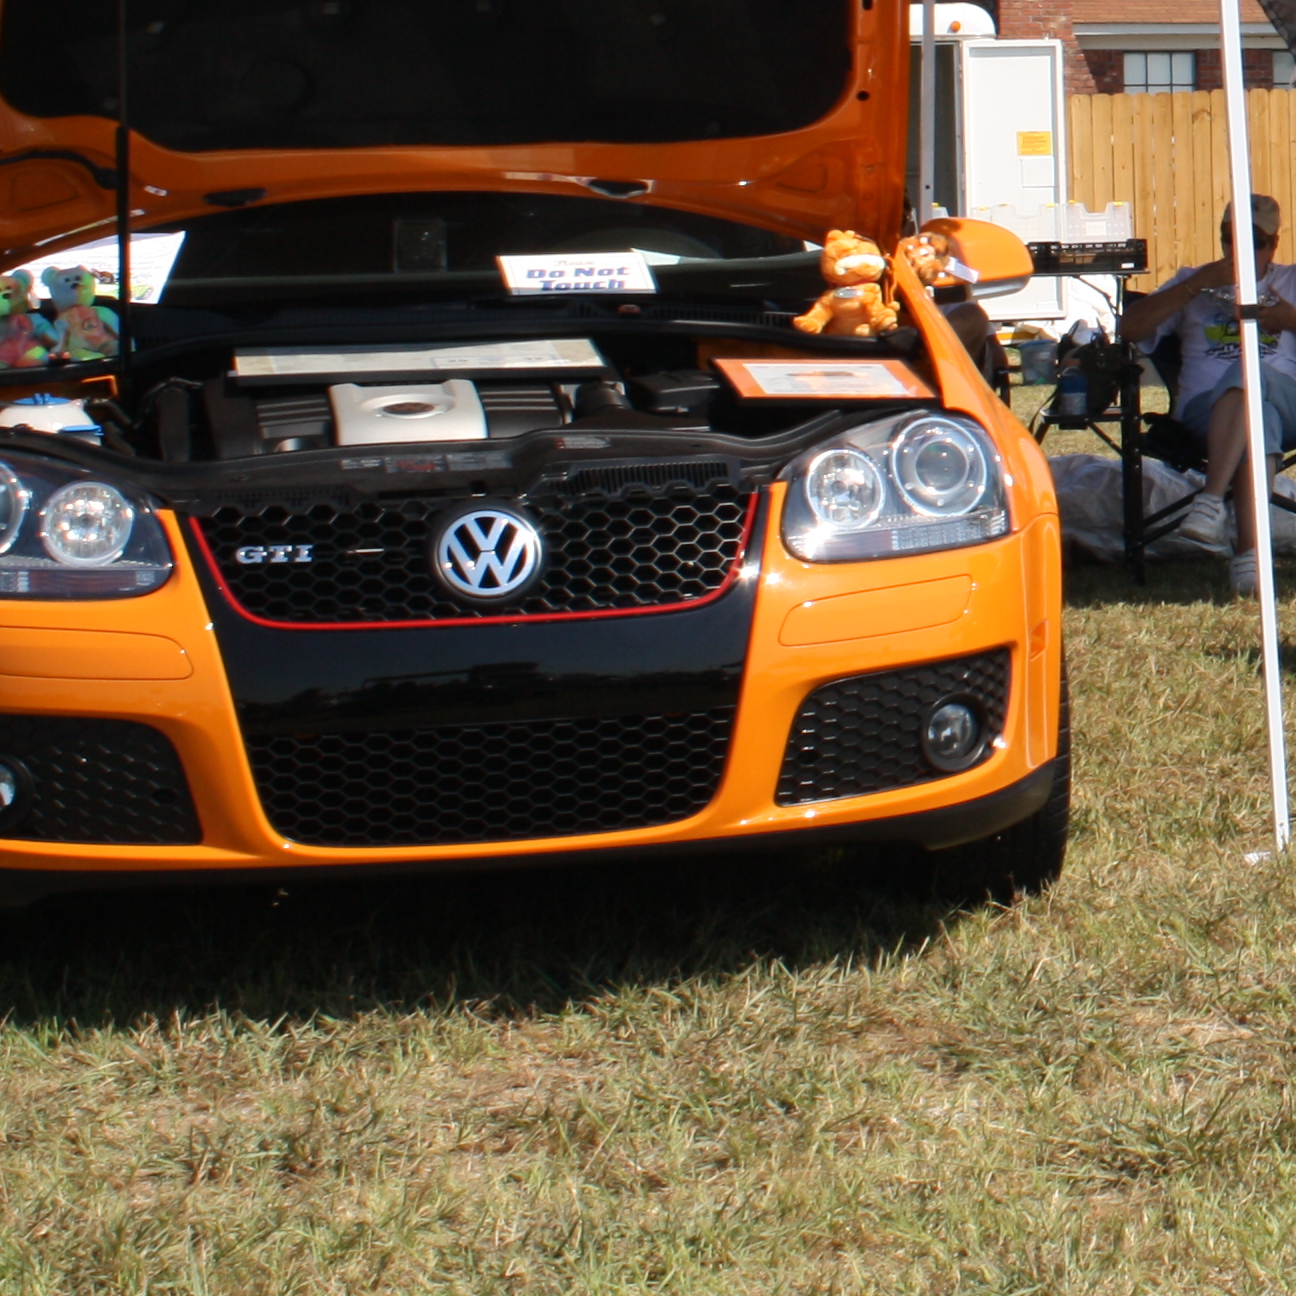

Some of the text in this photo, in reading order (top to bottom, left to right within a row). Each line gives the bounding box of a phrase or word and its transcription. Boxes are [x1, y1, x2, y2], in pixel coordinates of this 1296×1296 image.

[525, 265, 631, 280] Do Not
[538, 278, 627, 292] Touch
[235, 543, 314, 565] GTI
[437, 508, 541, 597] VW
